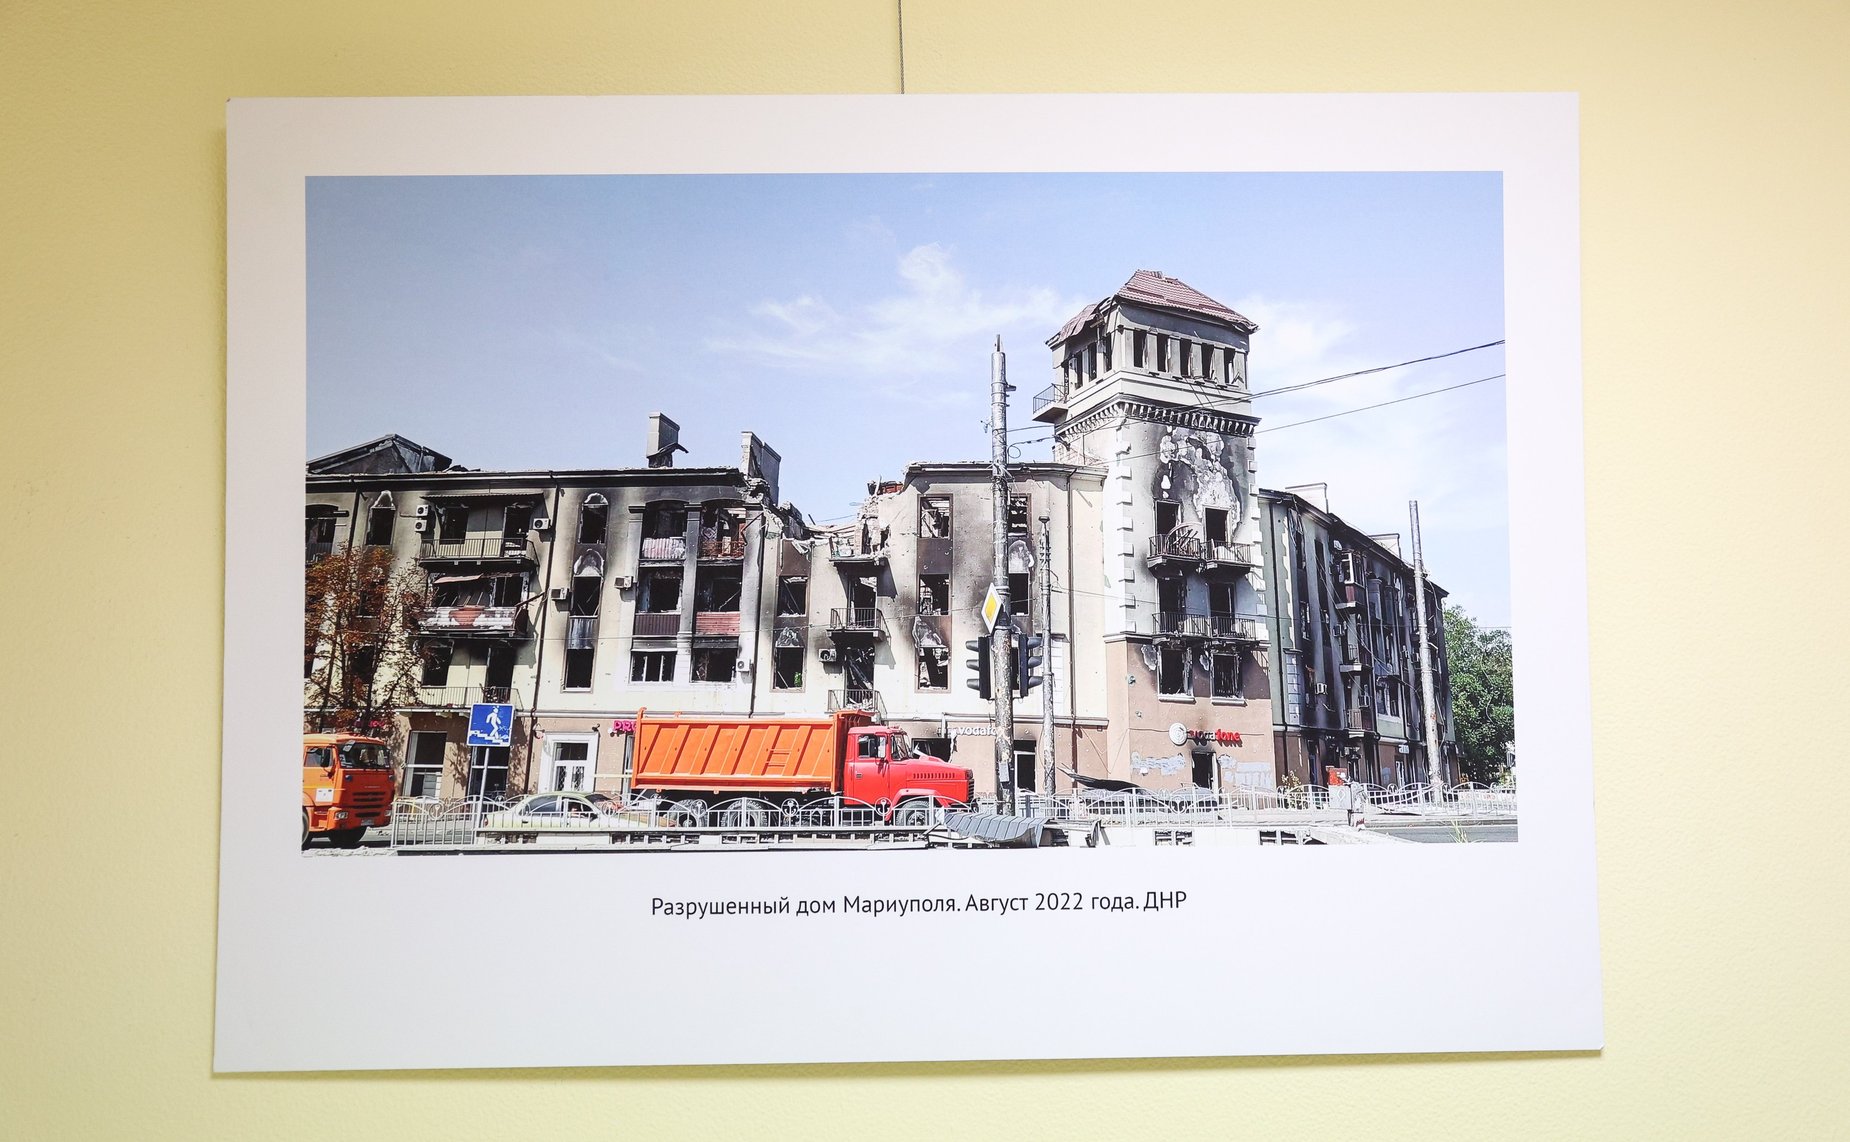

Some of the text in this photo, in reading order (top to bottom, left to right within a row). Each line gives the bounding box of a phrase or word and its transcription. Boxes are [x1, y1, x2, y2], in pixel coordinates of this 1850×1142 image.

[958, 724, 998, 737] vodafo
[652, 890, 1187, 920] Разрушенный дом Мариуполя. Август 2022 года. ДНР
